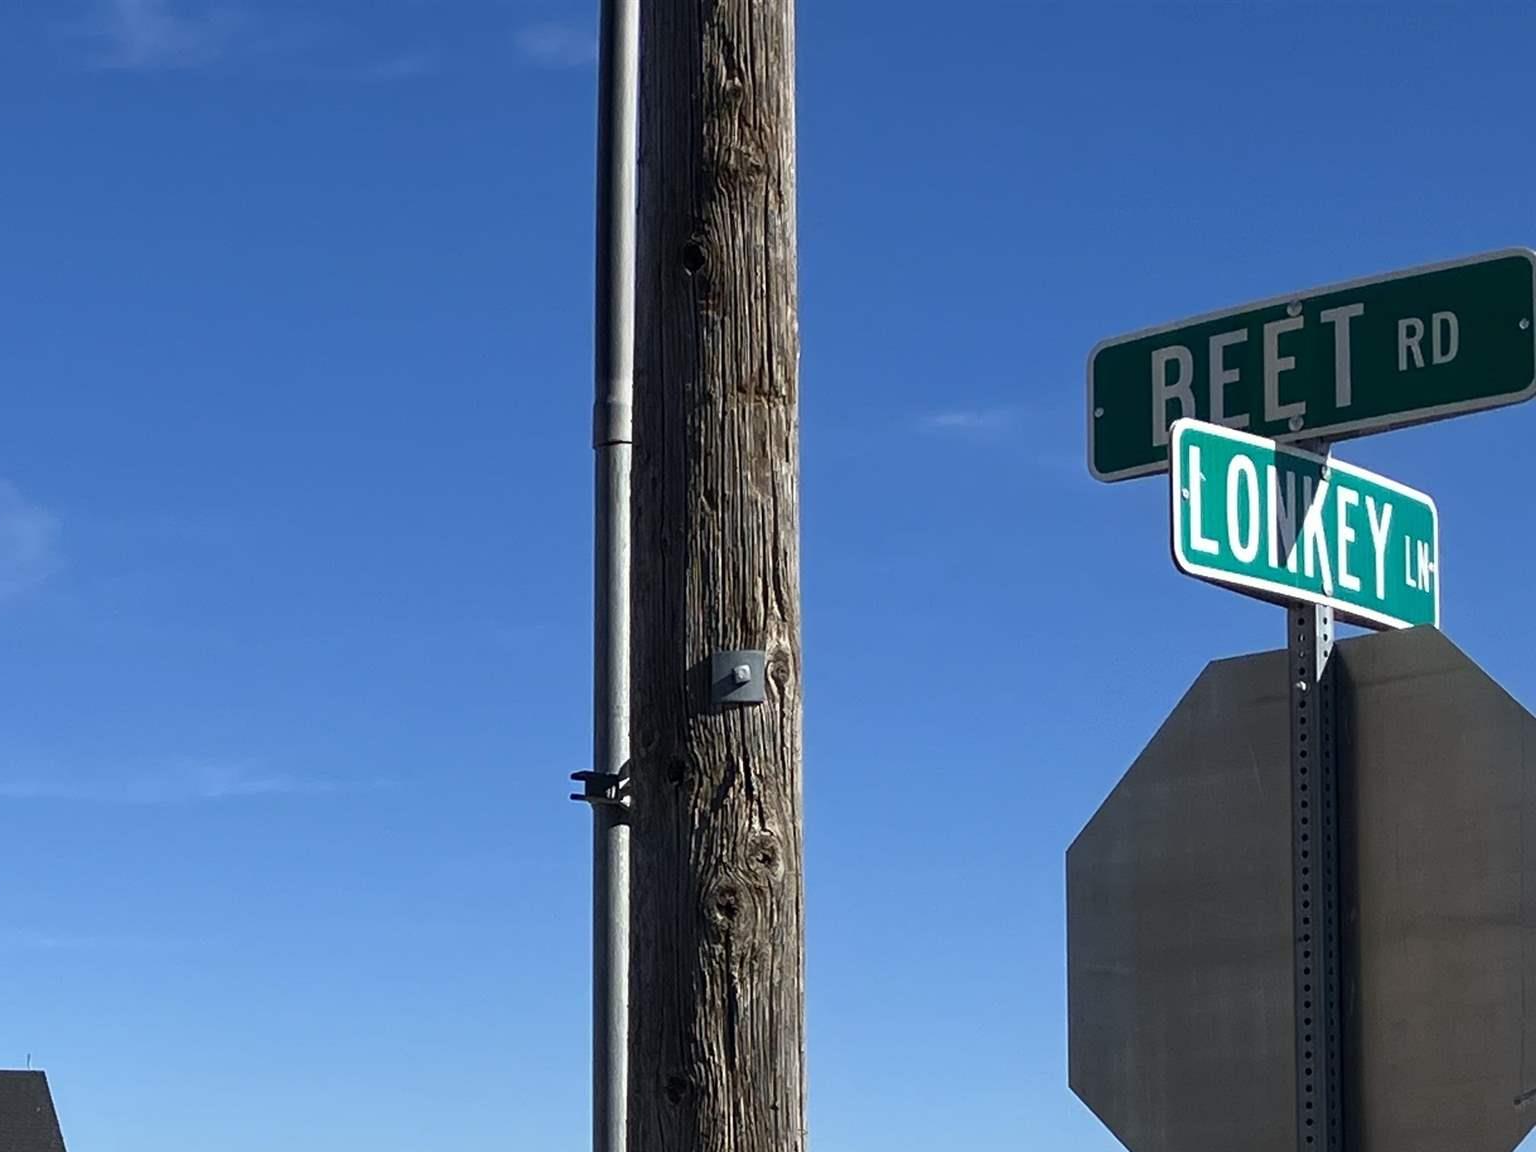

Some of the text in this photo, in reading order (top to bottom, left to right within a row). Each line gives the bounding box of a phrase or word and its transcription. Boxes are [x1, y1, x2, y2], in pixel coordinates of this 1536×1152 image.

[1151, 302, 1460, 447] BEET RD
[1188, 445, 1431, 600] LONKEY LN
